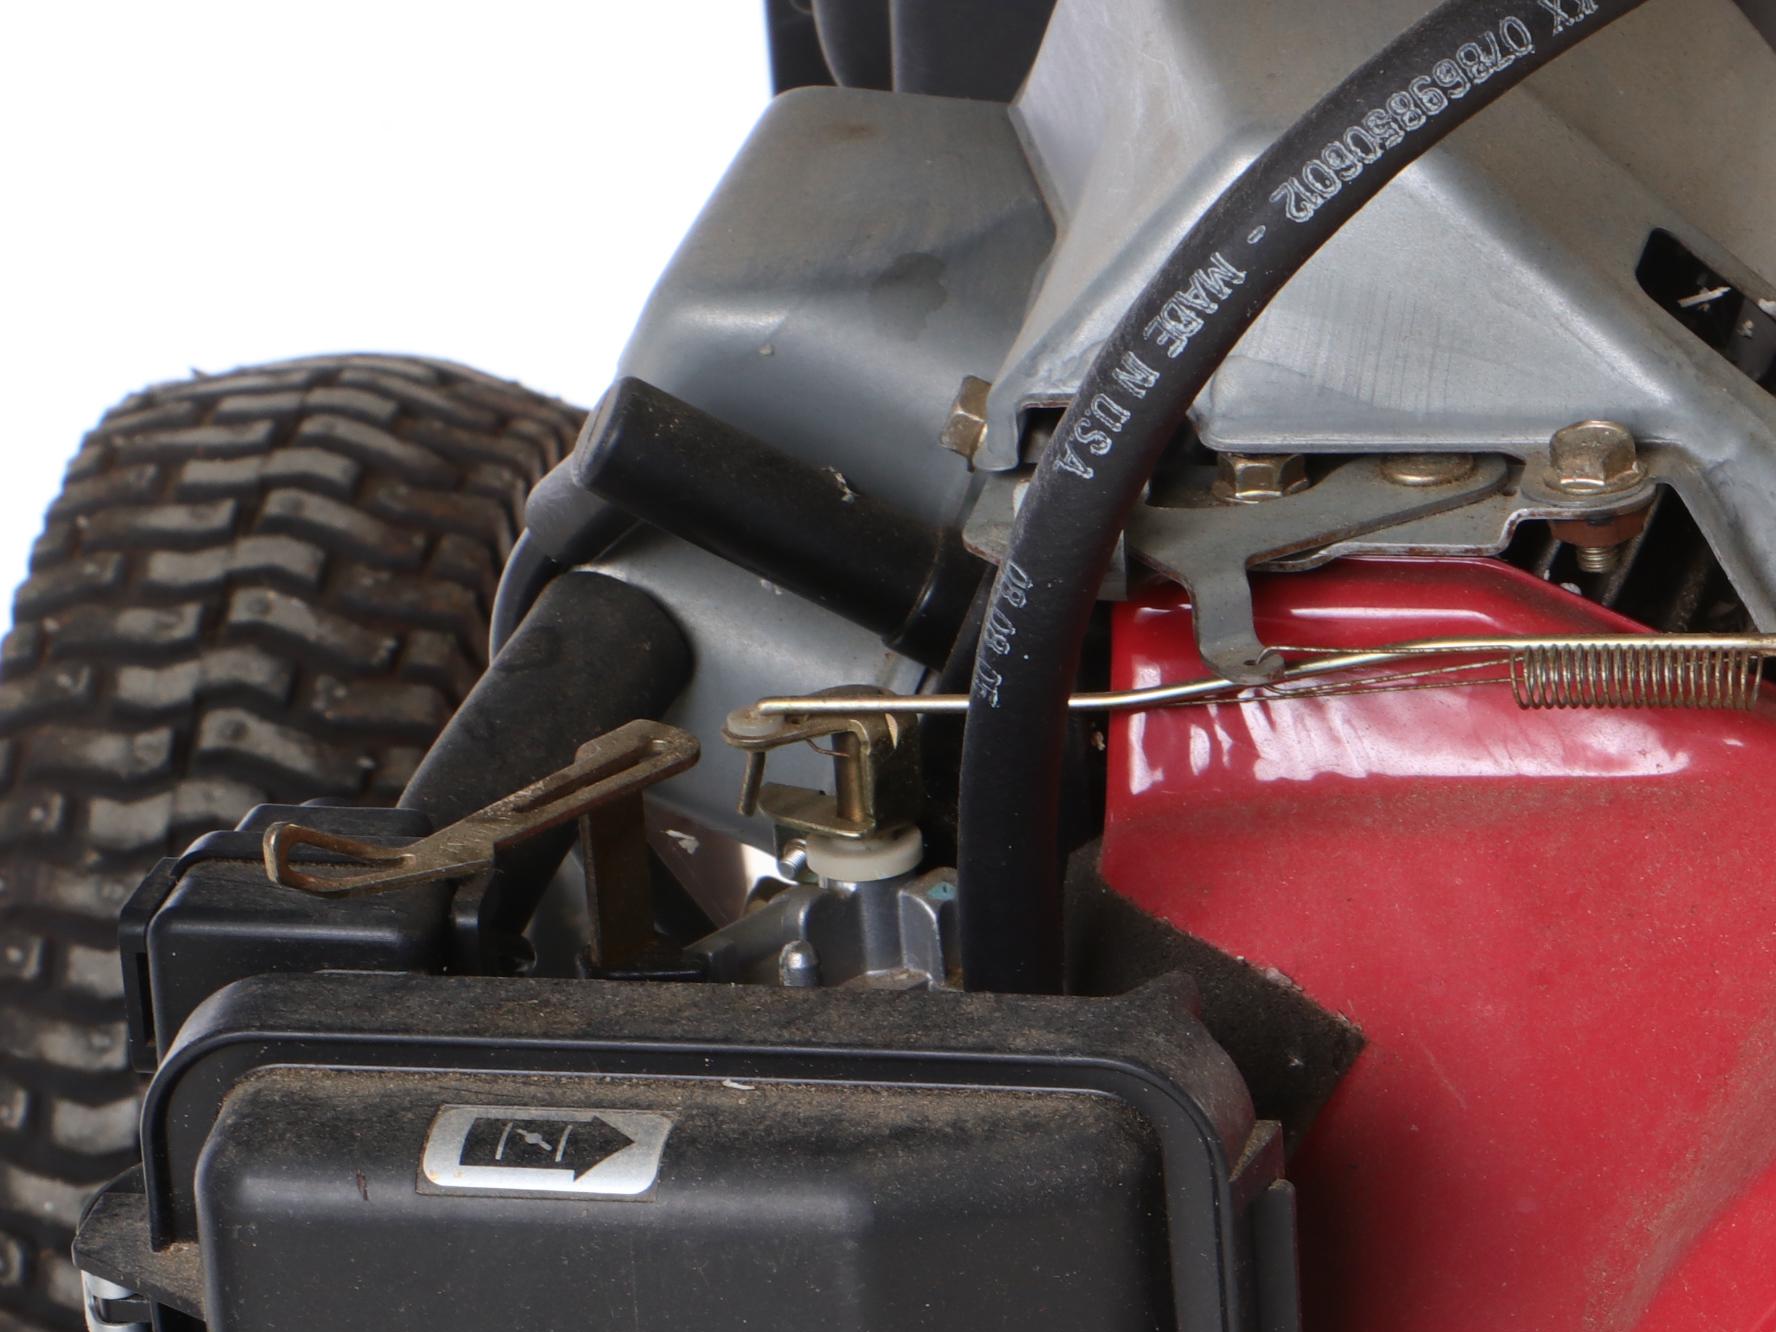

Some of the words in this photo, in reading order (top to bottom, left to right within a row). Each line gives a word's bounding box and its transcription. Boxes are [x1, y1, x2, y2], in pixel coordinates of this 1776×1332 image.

[1269, 16, 1535, 223] 078698506012
[1143, 252, 1248, 359] MADE
[1112, 351, 1160, 399] IN
